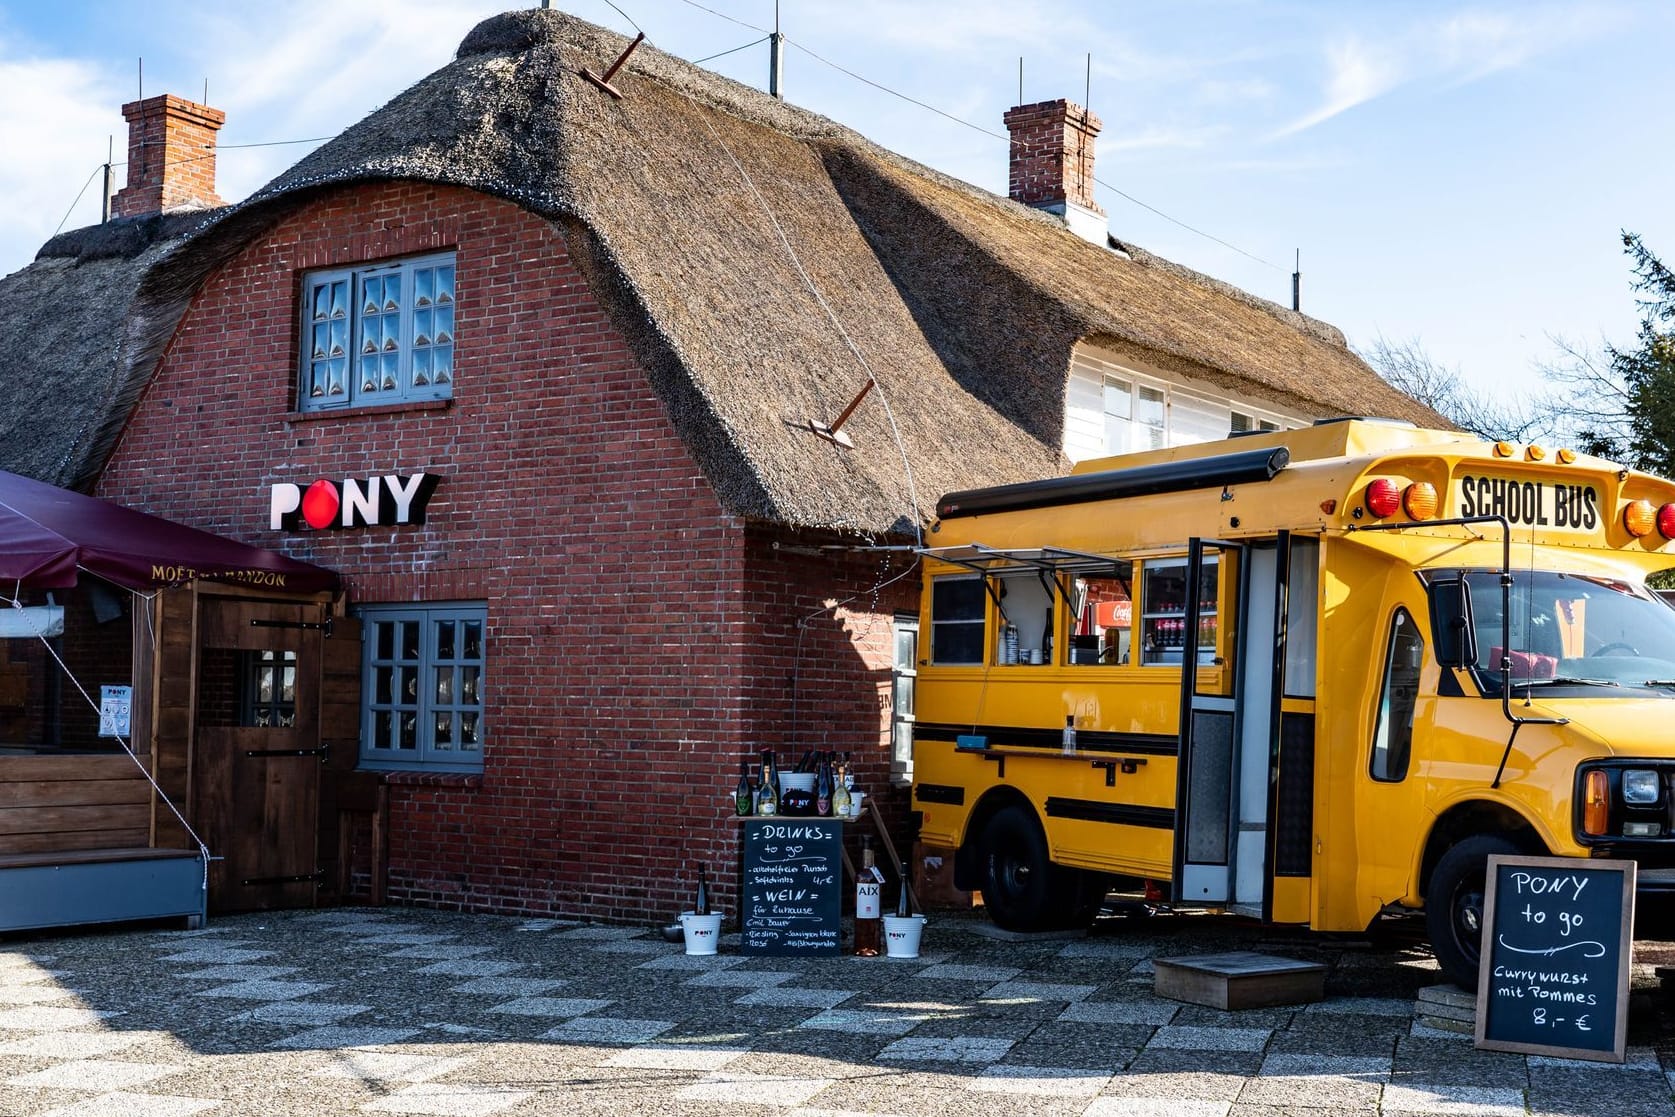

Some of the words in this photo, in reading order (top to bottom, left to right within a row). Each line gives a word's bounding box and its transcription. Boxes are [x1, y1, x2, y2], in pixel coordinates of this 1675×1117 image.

[270, 472, 428, 530] PONY
[1461, 475, 1548, 526] SCHOOL
[1554, 484, 1597, 530] BUS
[107, 688, 126, 696] PONY
[764, 844, 778, 853] to
[785, 845, 804, 858] go
[801, 864, 828, 873] Punsch
[858, 887, 879, 896] AIX
[1510, 872, 1589, 901] PONY
[765, 888, 807, 902] WEIN
[752, 904, 767, 915] für
[772, 904, 815, 915] Zuhause
[1520, 903, 1546, 924] to
[1559, 911, 1584, 936] go
[1497, 986, 1525, 998] mit
[1527, 986, 1597, 1006] Pommes
[1575, 1014, 1593, 1032] €
